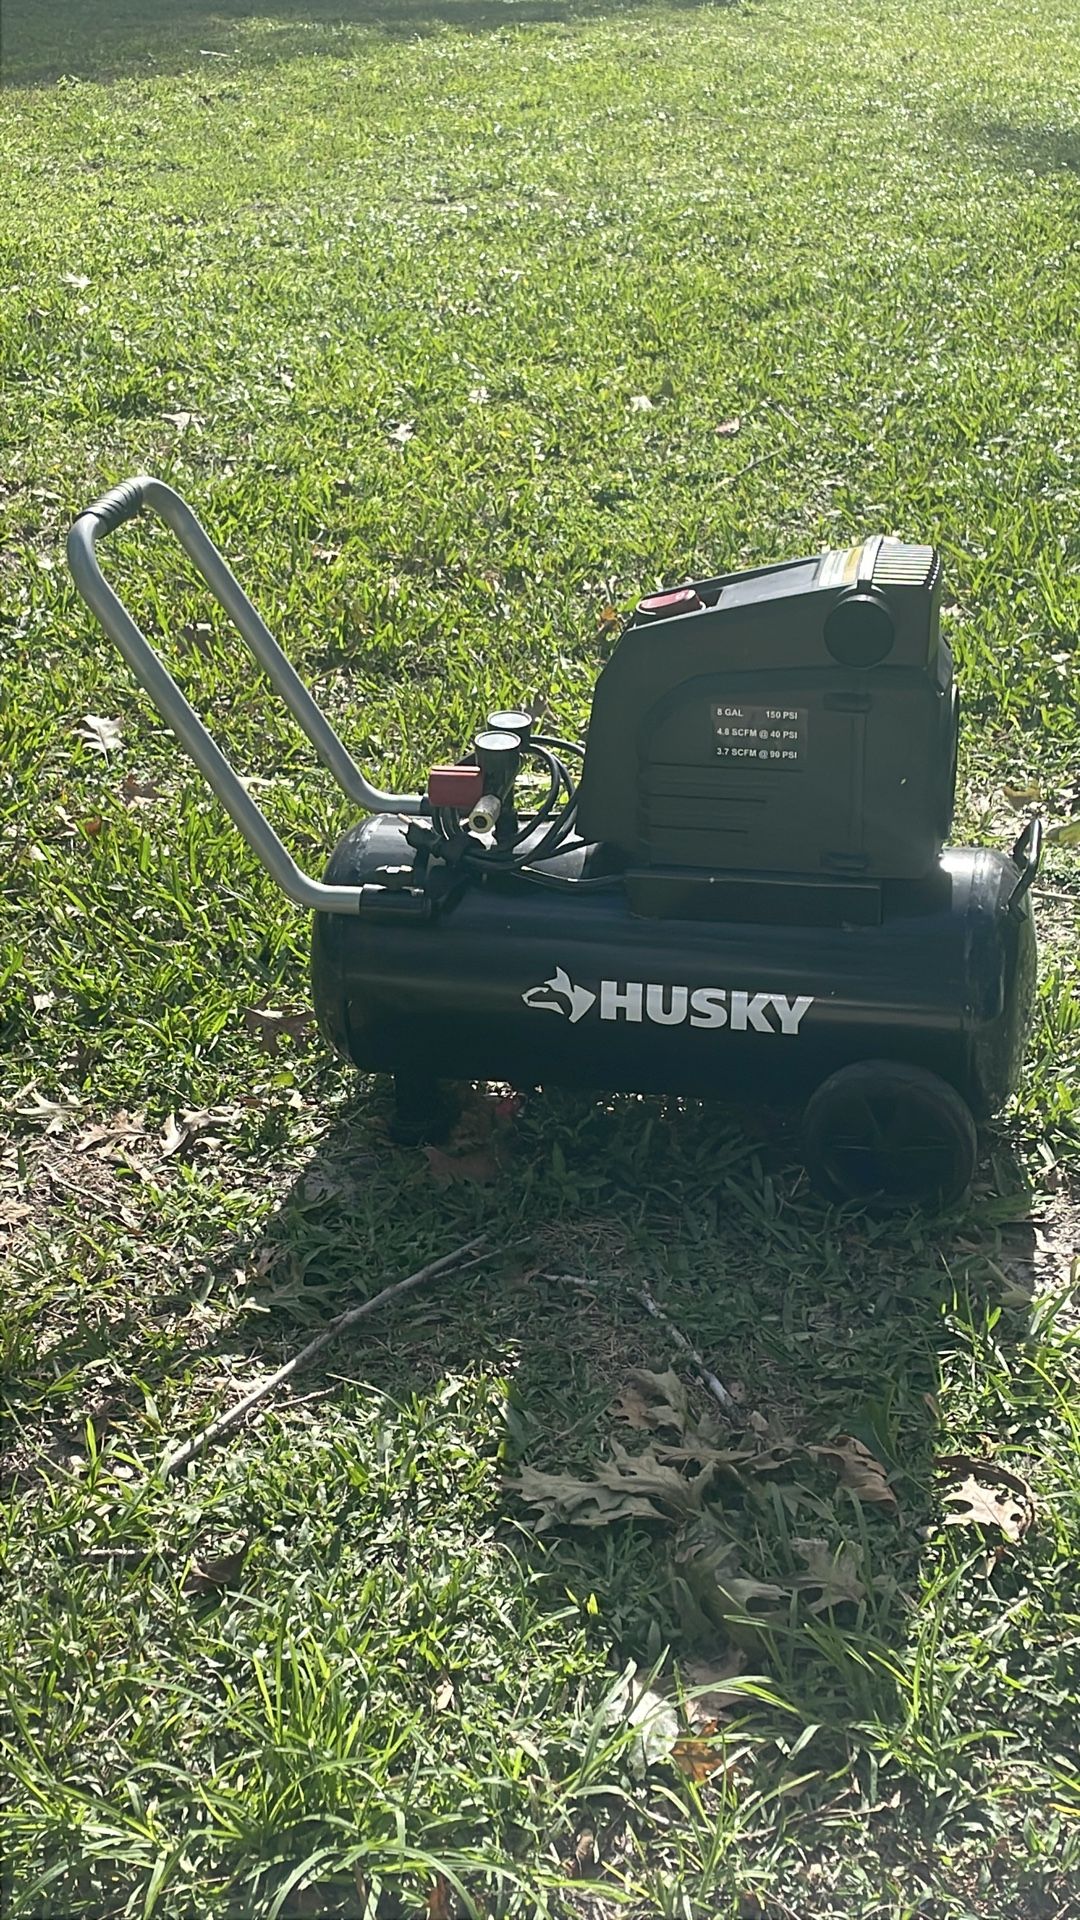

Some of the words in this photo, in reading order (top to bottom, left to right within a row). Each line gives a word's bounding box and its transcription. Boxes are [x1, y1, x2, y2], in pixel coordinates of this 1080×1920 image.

[717, 707, 723, 716] 8
[724, 708, 744, 717] GAL
[766, 710, 782, 719] 150
[782, 711, 798, 720] PSI
[717, 727, 730, 736] 4.8
[731, 728, 757, 737] SCFM
[758, 729, 769, 740] @
[769, 730, 781, 739] 40
[782, 731, 798, 739] PSI
[717, 747, 730, 756] 3.7
[731, 748, 757, 757] SCFM
[758, 749, 769, 760] @
[769, 750, 781, 758] 90
[782, 751, 798, 759] PSI
[600, 980, 815, 1035] HUSKY
